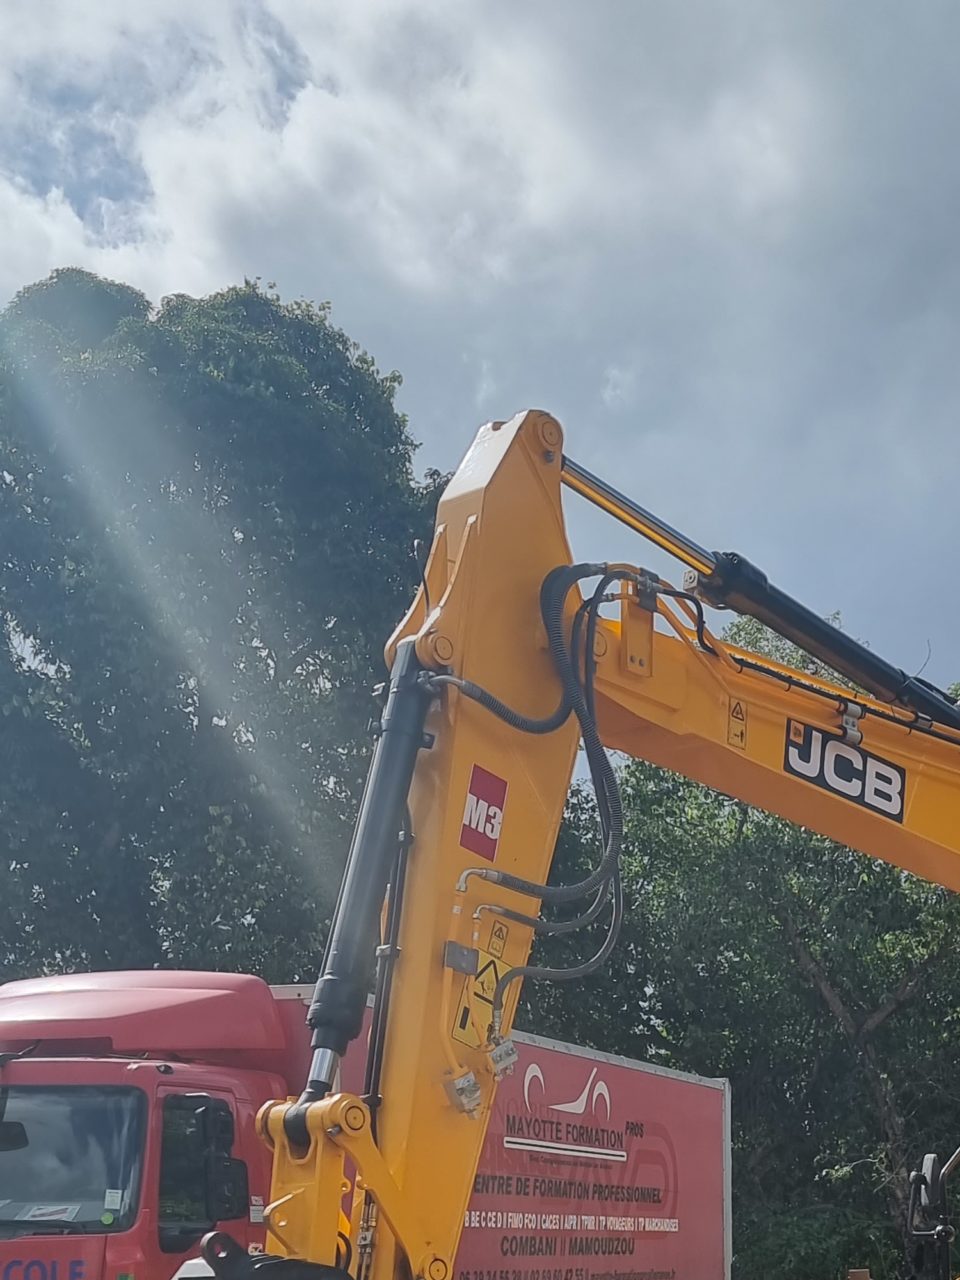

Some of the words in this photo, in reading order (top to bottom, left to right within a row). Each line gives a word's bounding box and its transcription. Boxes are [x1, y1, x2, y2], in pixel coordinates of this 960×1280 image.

[789, 730, 902, 815] JCB
[463, 793, 503, 840] M3
[505, 1114, 562, 1141] MAYOTTE
[566, 1123, 623, 1149] FORMATION
[625, 1120, 645, 1138] PROS
[515, 1177, 530, 1197] DE
[533, 1179, 590, 1200] FORMATION
[592, 1184, 662, 1204] PROFESSIONNEL
[471, 1211, 480, 1228] BE
[481, 1211, 486, 1228] C
[487, 1211, 496, 1228] CE
[497, 1212, 502, 1228] D
[524, 1213, 536, 1229] FCO
[541, 1213, 560, 1230] CACES
[501, 1235, 557, 1256] COMBANI
[569, 1237, 635, 1256] MAMOUDZOU
